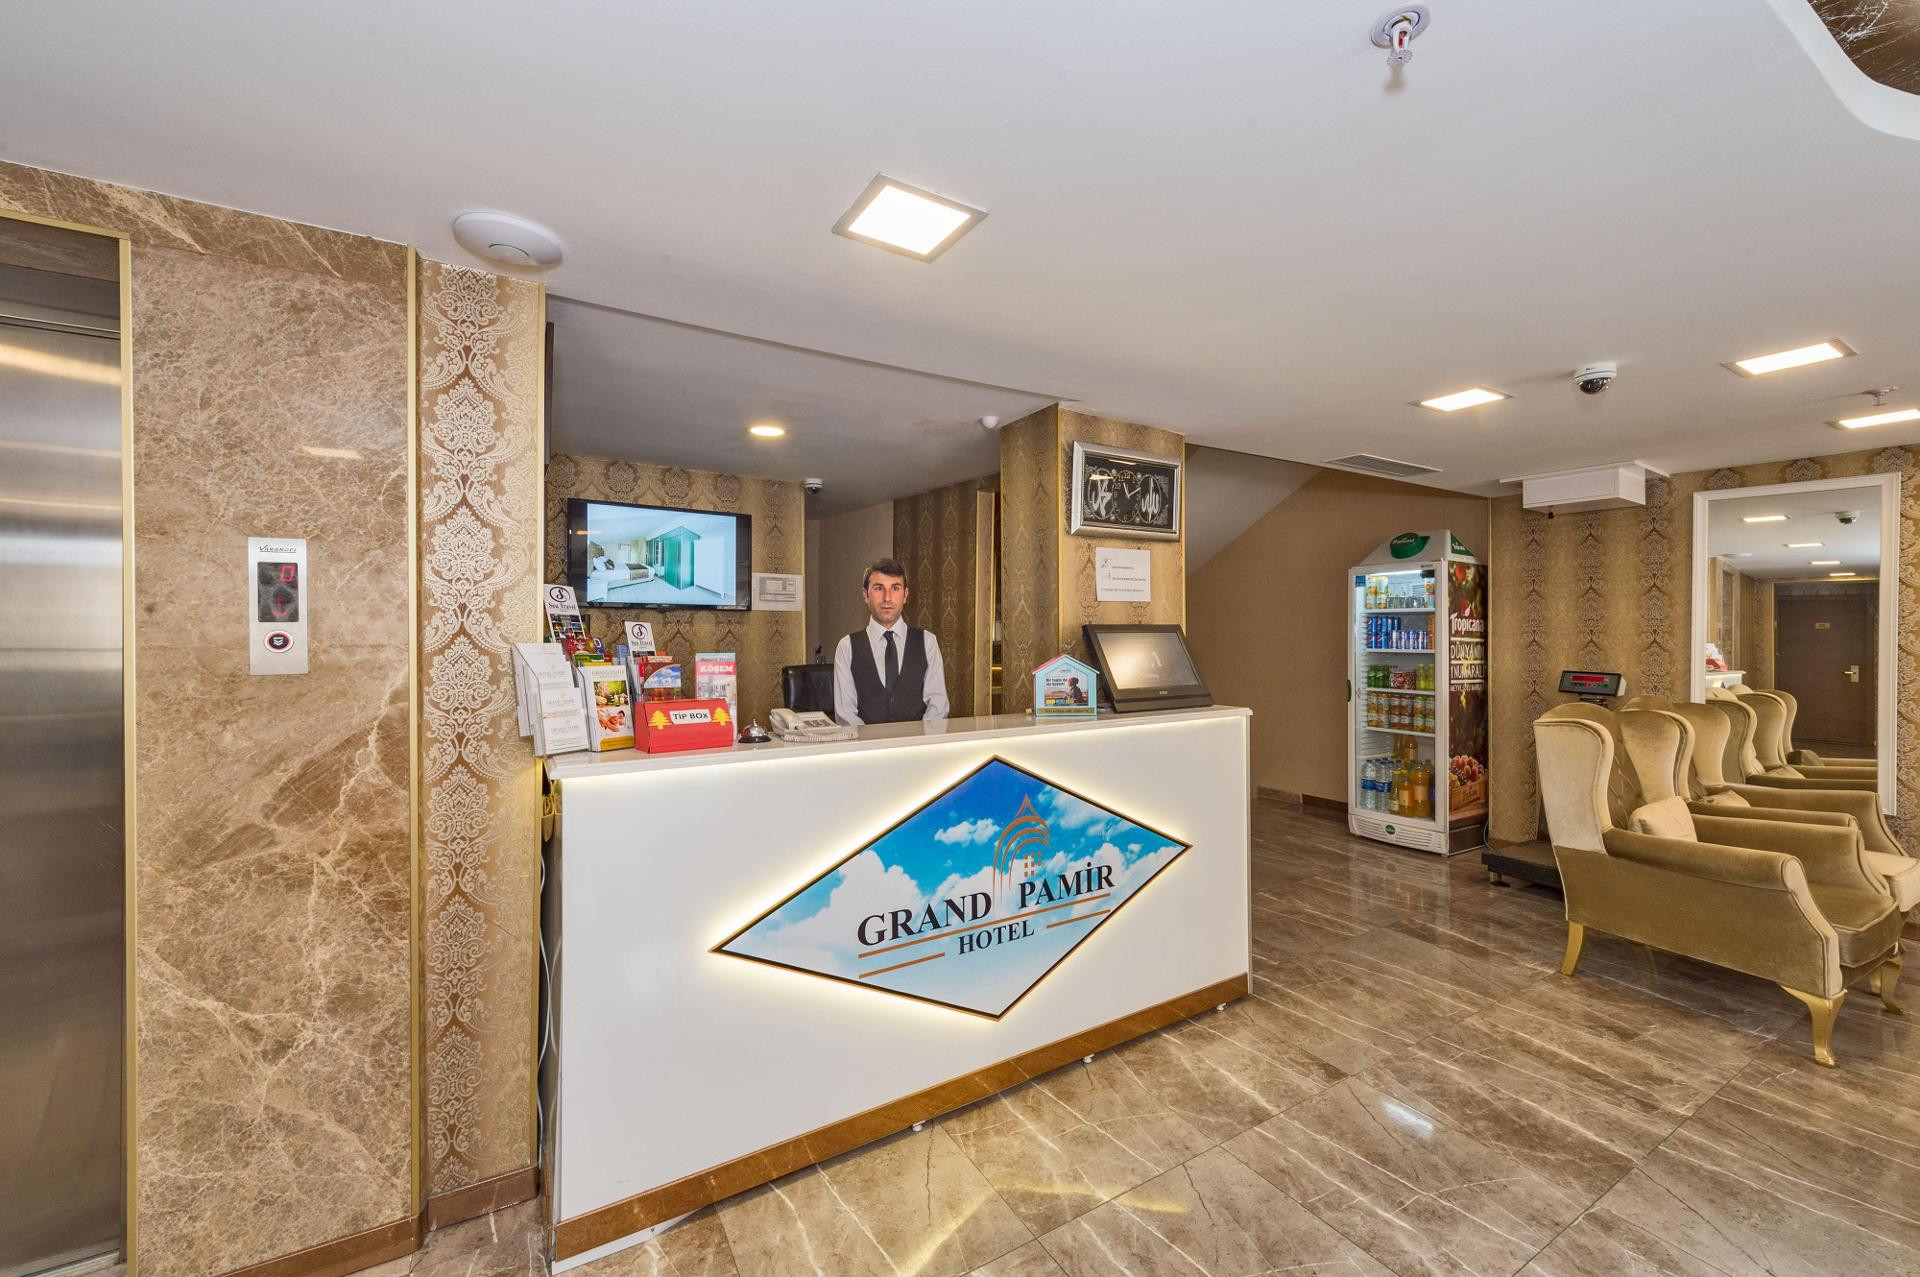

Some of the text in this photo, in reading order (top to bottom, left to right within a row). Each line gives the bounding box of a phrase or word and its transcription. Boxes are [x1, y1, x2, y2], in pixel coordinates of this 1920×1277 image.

[1450, 612, 1484, 635] Tropicana
[857, 862, 1115, 946] GRAND PAMİR
[958, 919, 1035, 955] HOTEL
